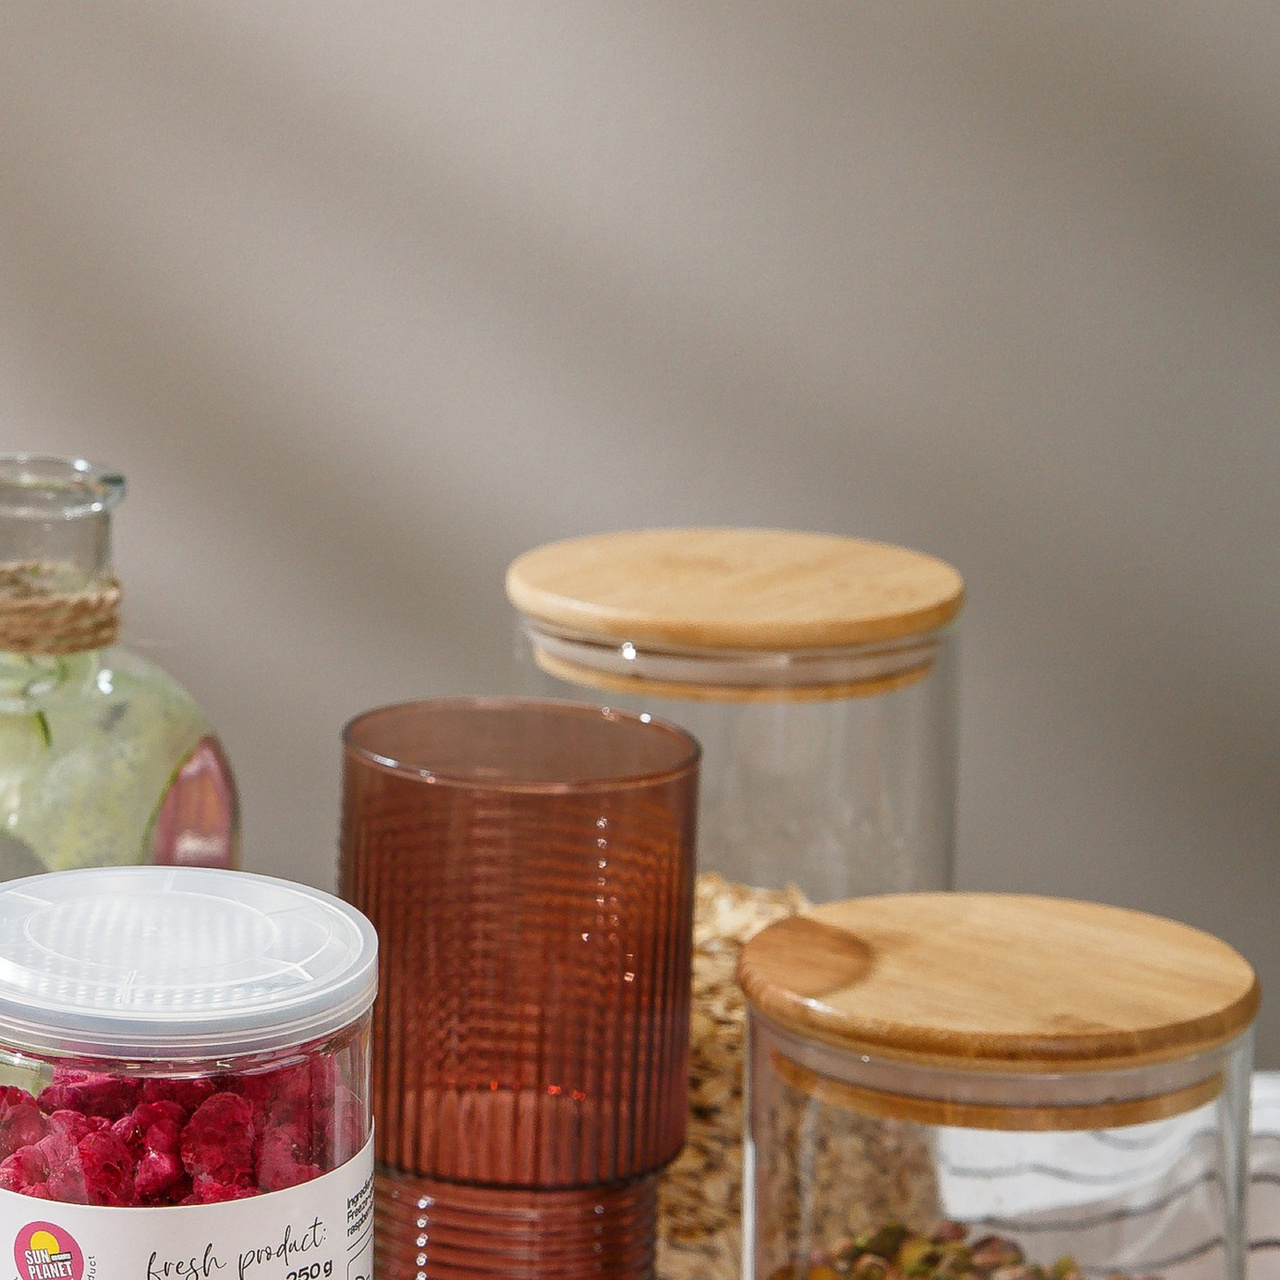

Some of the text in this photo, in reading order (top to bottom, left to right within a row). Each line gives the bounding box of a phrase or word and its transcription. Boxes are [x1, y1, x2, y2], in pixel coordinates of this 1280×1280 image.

[25, 1248, 50, 1265] SUN
[28, 1261, 74, 1280] PLANET
[324, 1259, 333, 1278] g
